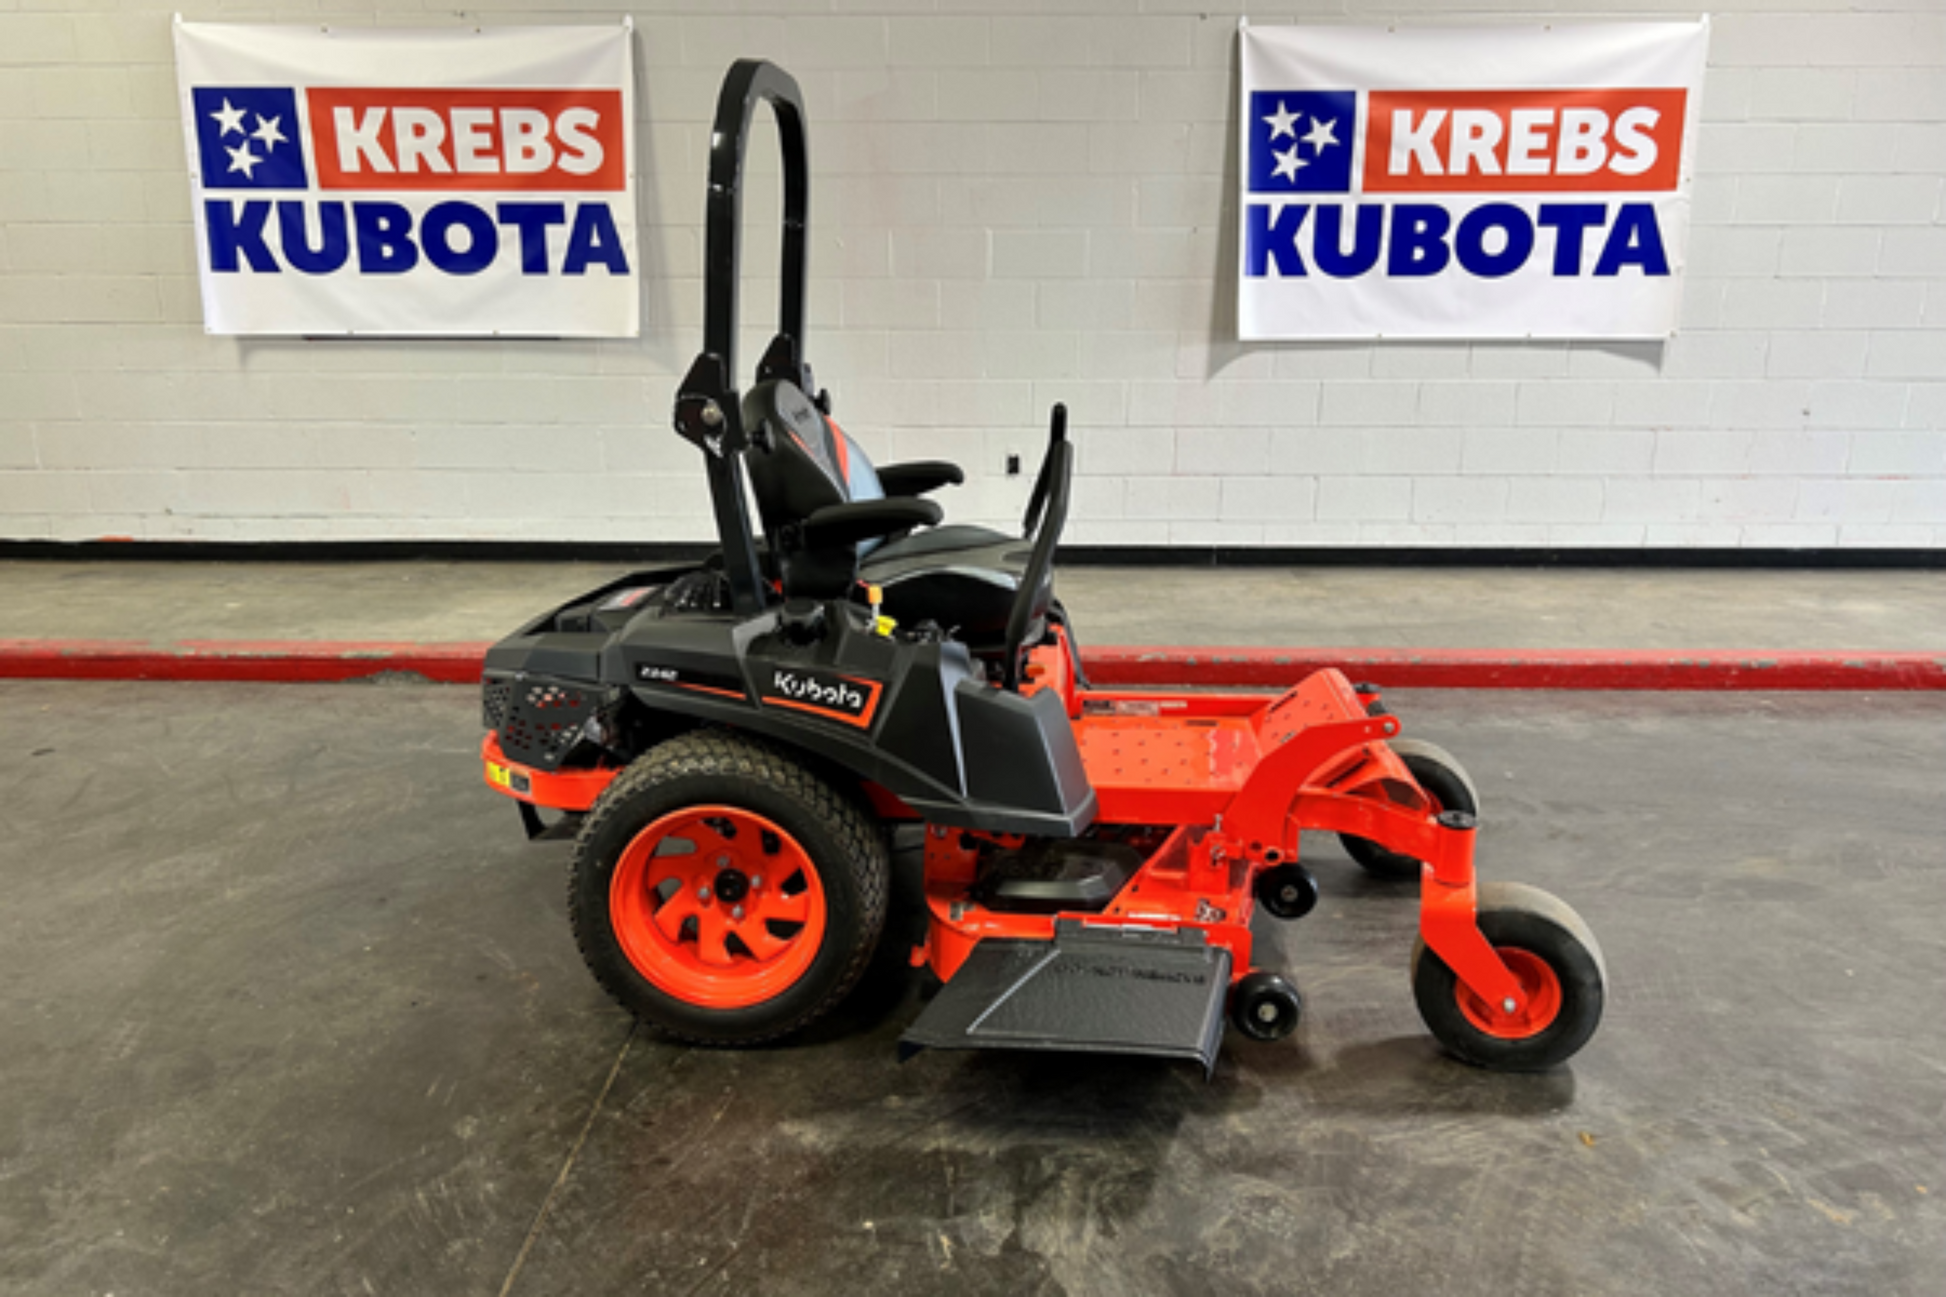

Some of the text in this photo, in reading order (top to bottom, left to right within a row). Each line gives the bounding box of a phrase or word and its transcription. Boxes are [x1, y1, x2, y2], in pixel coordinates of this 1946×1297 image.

[332, 106, 604, 175] KREBS
[1388, 106, 1661, 176] KREBS
[204, 199, 630, 275] KUBOTA
[1245, 201, 1671, 279] KUBOTA
[774, 670, 863, 708] Kubota
